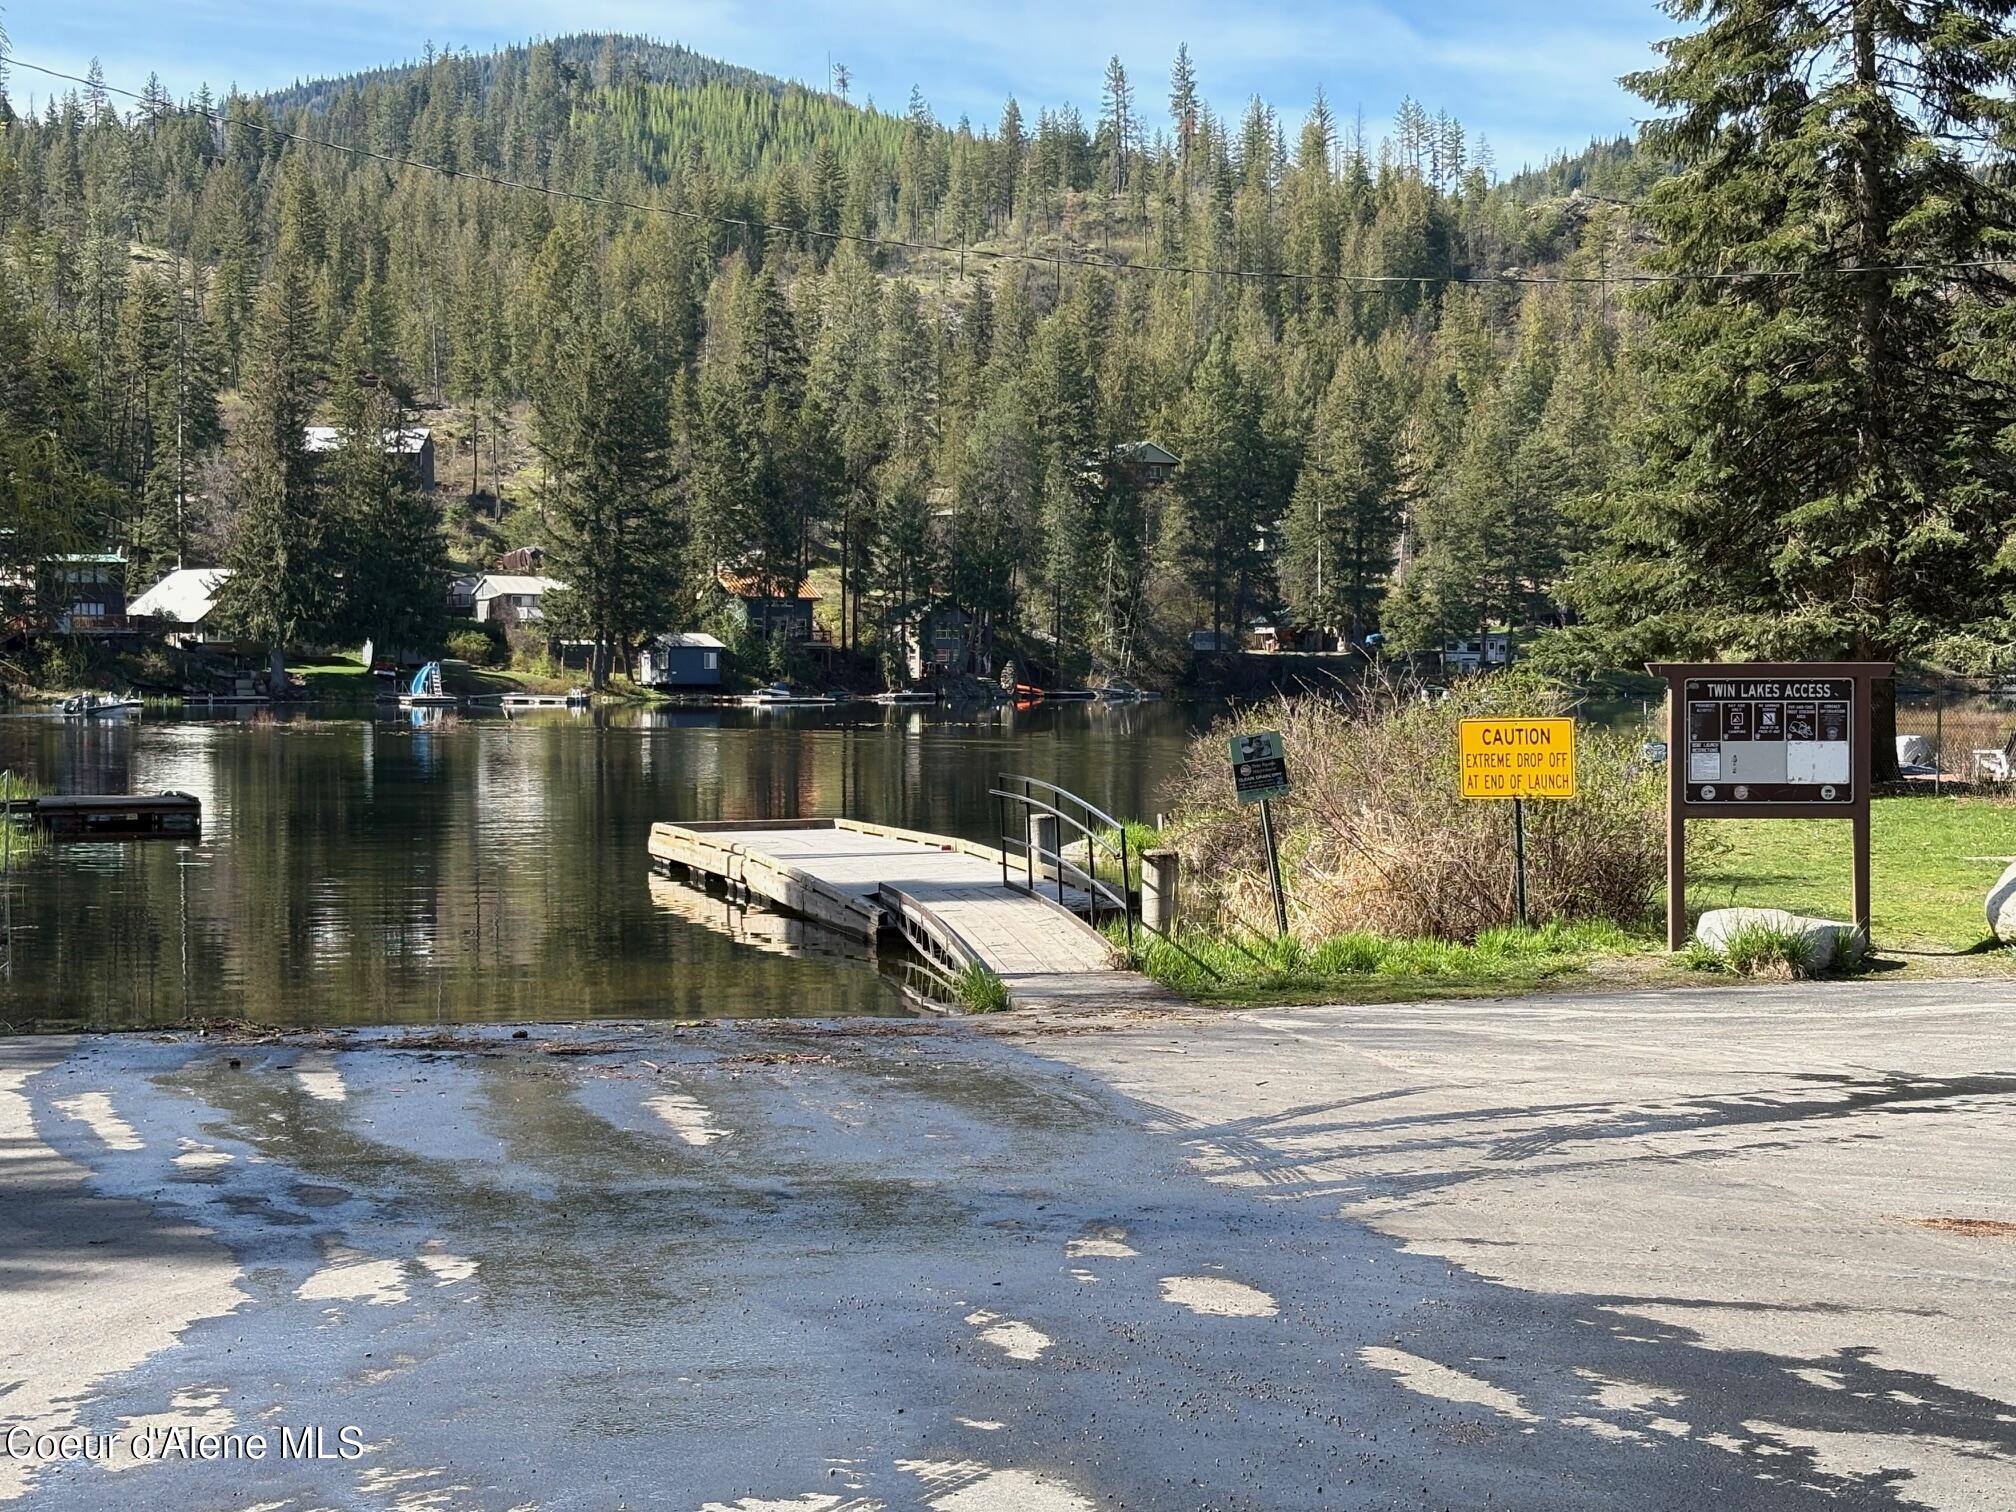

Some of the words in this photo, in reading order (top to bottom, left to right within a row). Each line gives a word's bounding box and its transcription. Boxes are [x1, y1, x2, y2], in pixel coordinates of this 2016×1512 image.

[1707, 683, 1735, 698] TWIN
[1741, 683, 1780, 698] LAKES
[1784, 683, 1831, 698] ACCESS
[1481, 728, 1551, 746] CAUTION
[1466, 753, 1511, 768] EXTREME
[1517, 752, 1543, 768] DROP
[1549, 752, 1568, 767] OFF
[1466, 775, 1478, 790] AT
[1484, 774, 1504, 790] END
[1510, 774, 1522, 790] OF
[1528, 774, 1569, 790] LAUNCH
